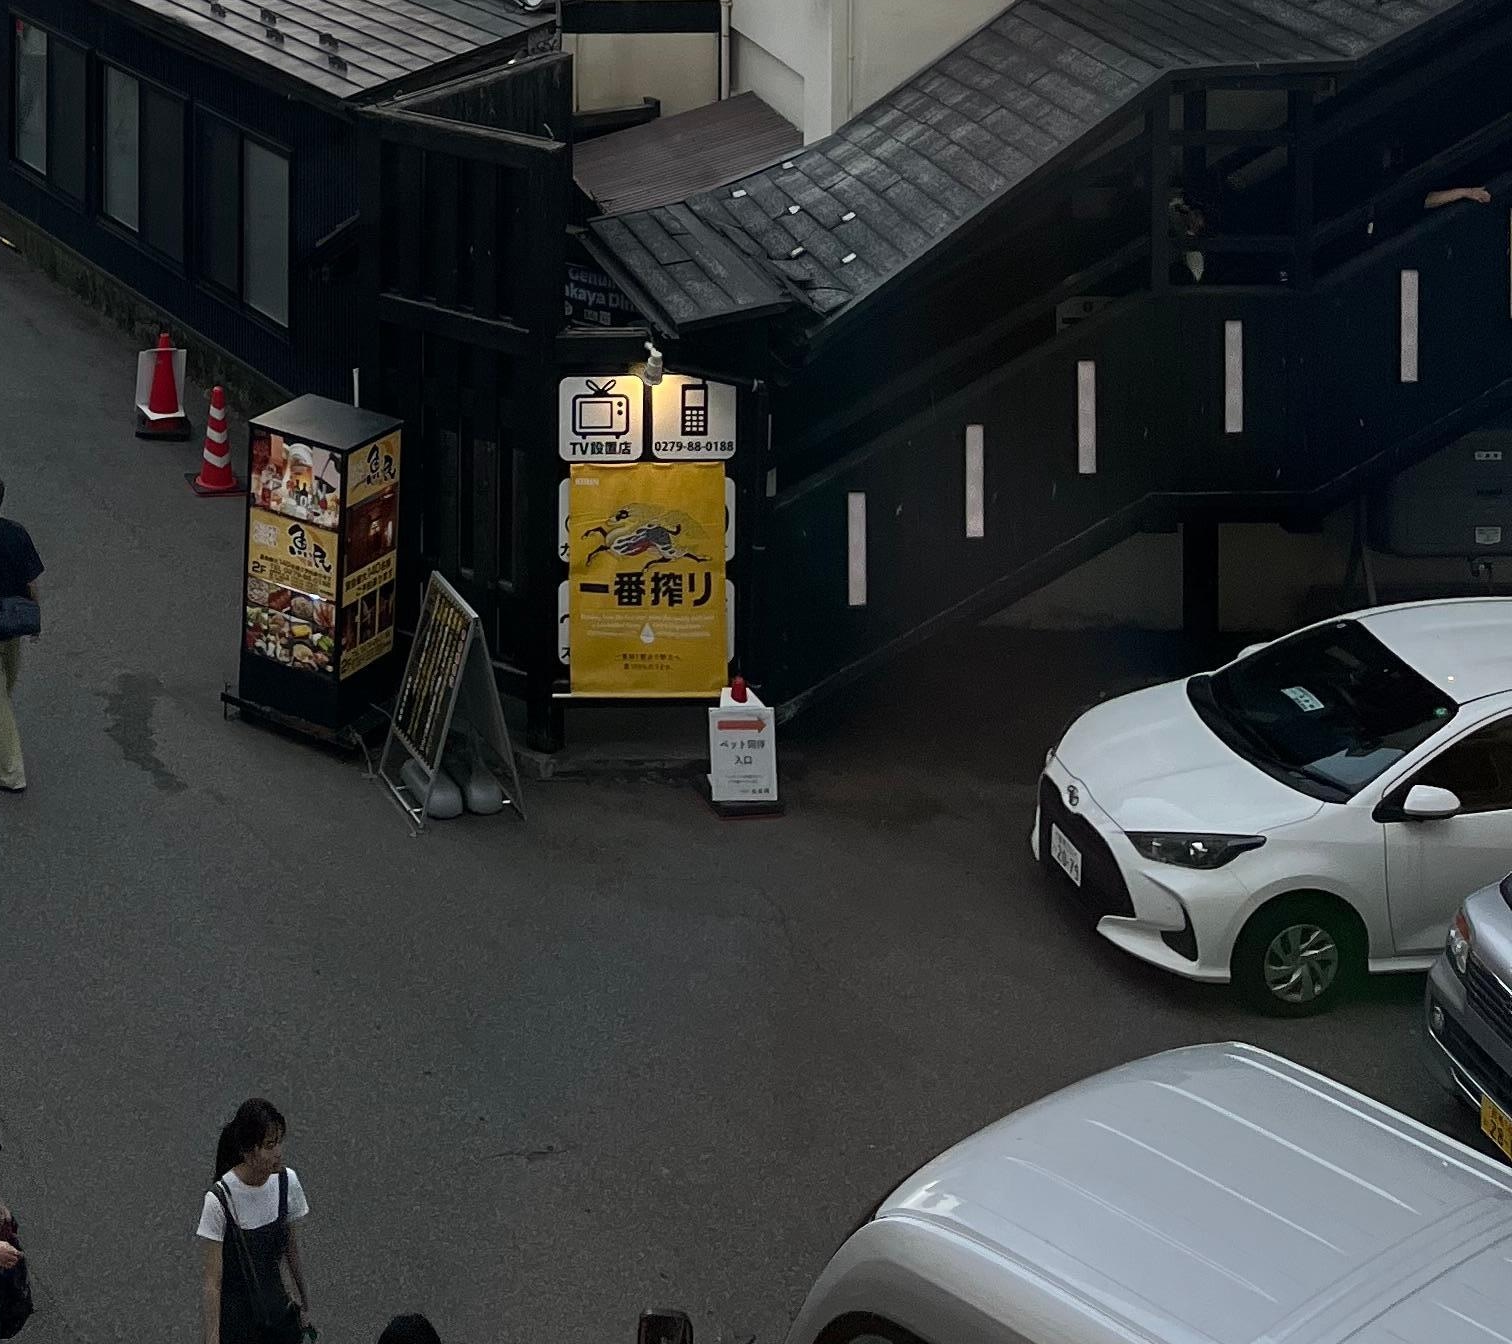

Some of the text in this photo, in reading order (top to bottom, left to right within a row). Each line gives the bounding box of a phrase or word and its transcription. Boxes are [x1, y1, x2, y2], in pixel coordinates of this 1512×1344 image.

[570, 441, 632, 455] TV設置店
[654, 441, 734, 452] 0279-88-0188
[252, 560, 267, 573] 2F
[579, 571, 712, 607] 一番搾り
